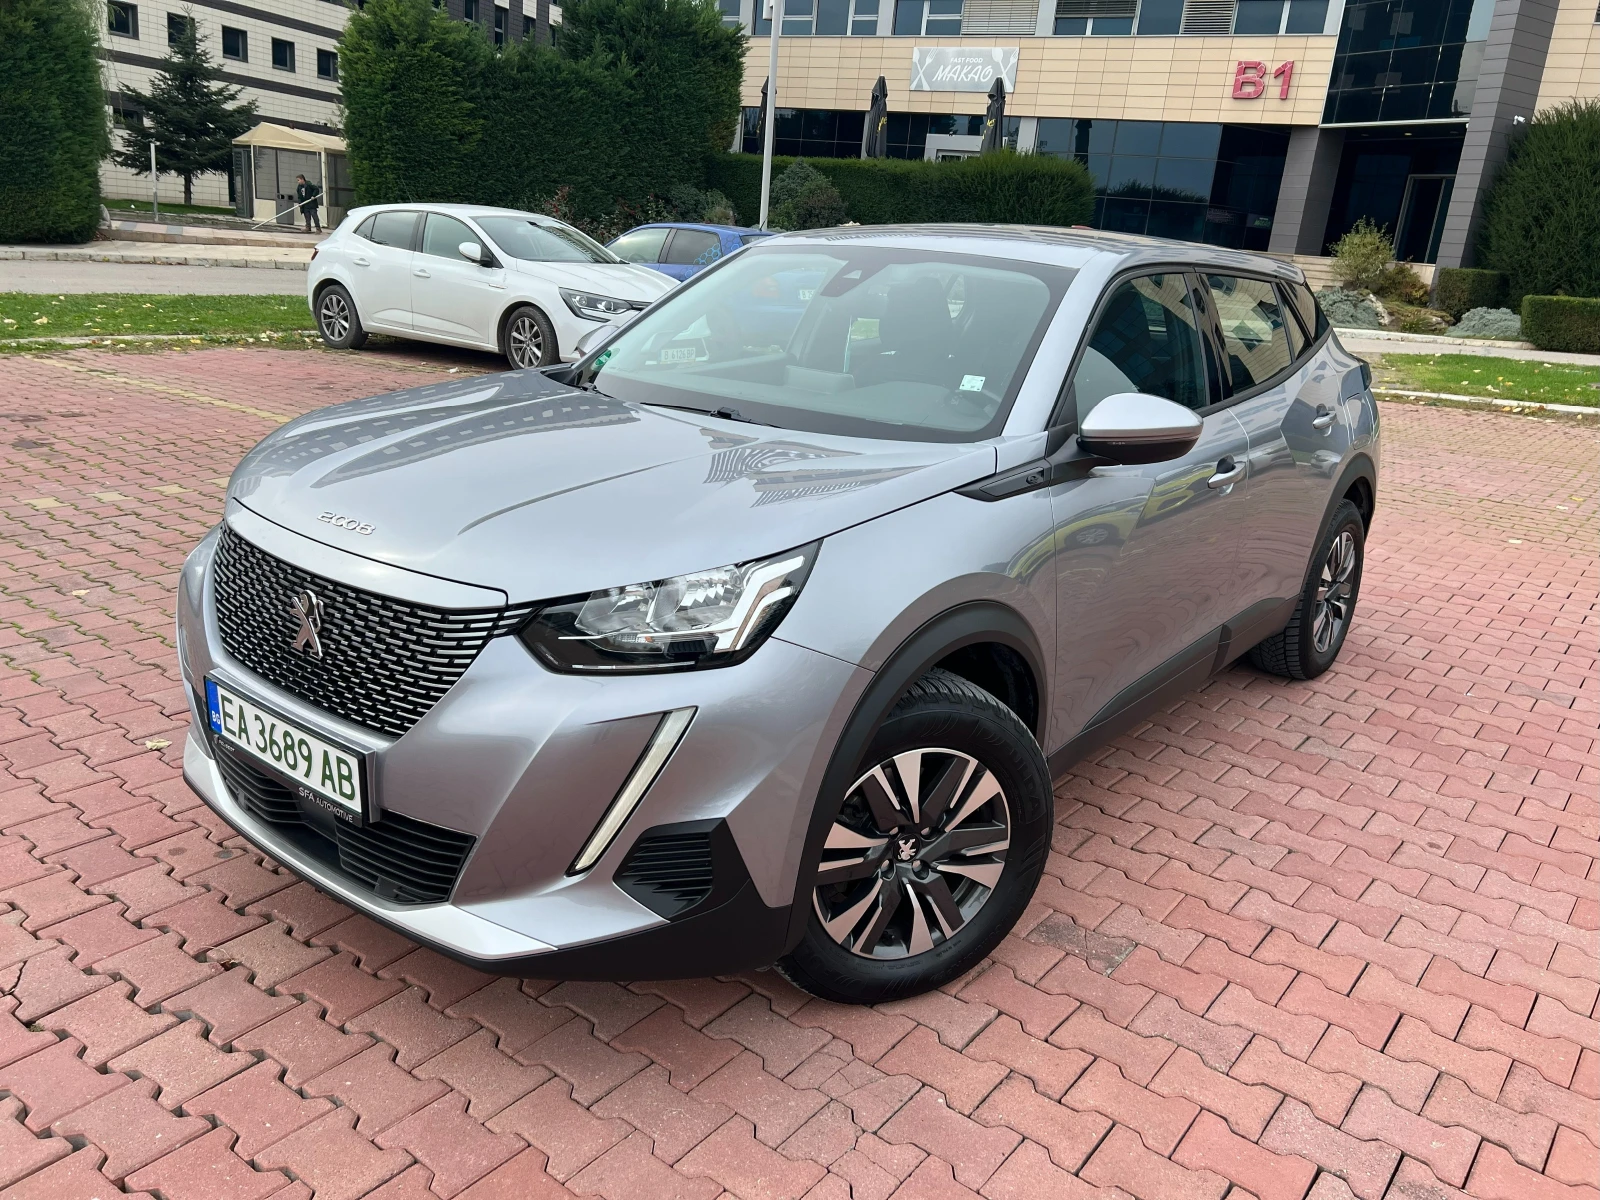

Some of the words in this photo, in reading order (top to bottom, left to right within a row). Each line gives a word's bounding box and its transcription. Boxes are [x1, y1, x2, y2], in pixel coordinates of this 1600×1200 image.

[932, 64, 993, 82] MAKAO
[1232, 60, 1294, 100] B1
[317, 510, 376, 535] 2008
[220, 693, 251, 746] EA
[254, 713, 313, 779] 3689
[321, 749, 356, 801] AB
[298, 787, 315, 802] SFA
[315, 797, 353, 823] AUTOMOTIVE
